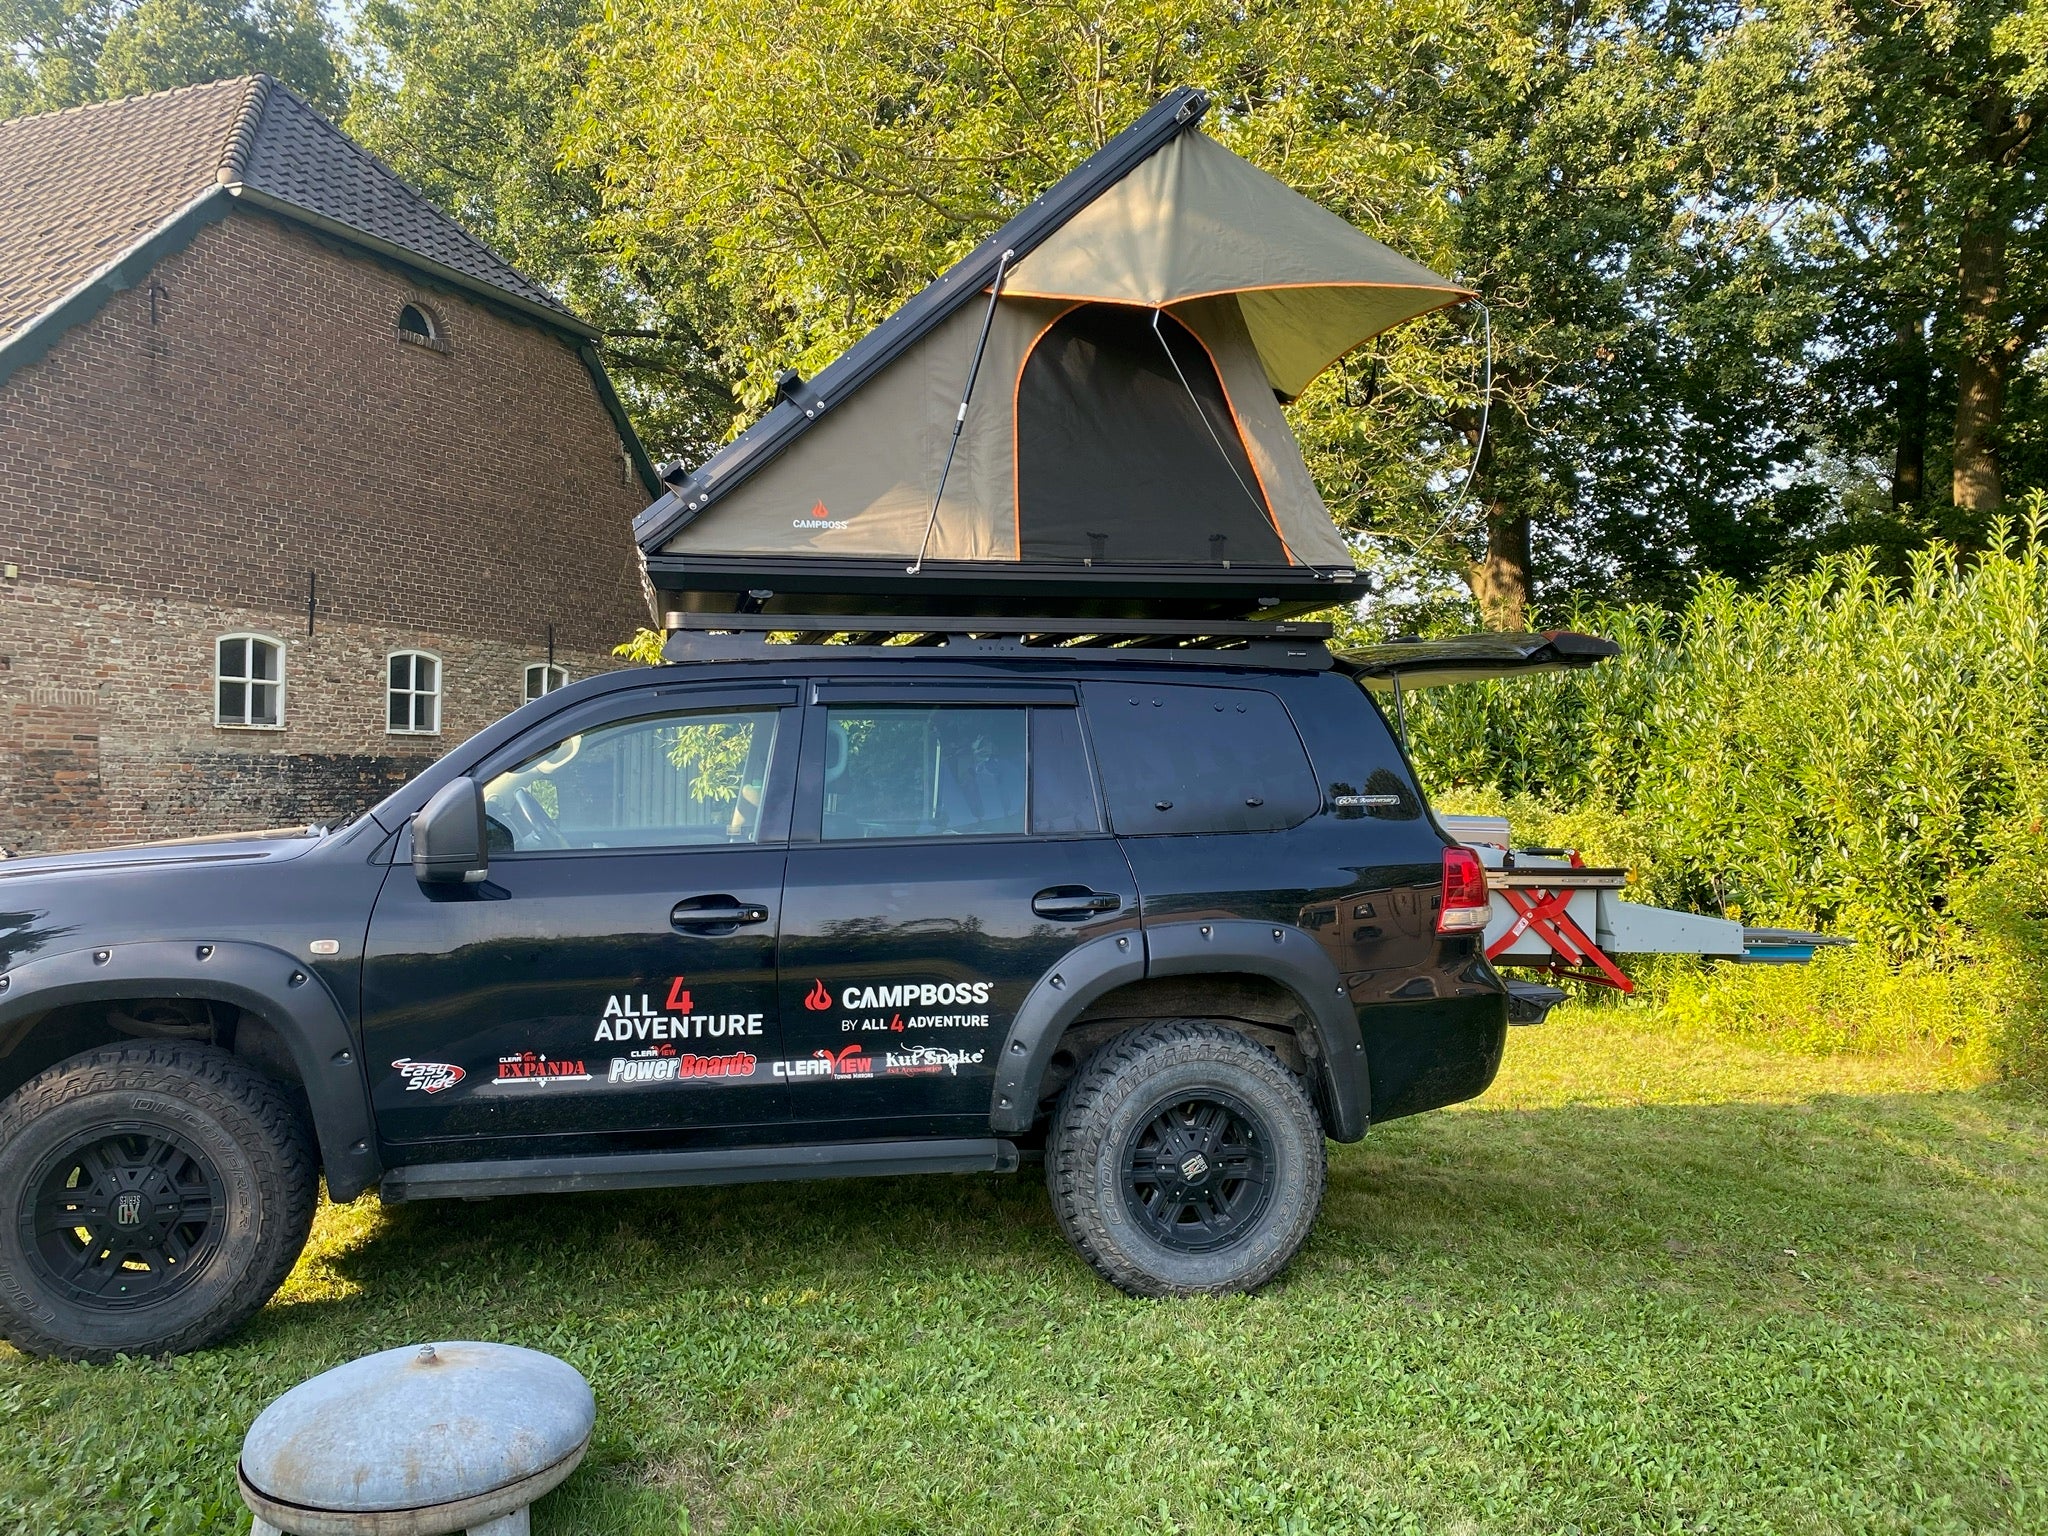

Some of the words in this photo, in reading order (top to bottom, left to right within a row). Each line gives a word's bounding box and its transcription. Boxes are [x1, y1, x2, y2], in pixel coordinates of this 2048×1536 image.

[793, 520, 847, 530] CAMPBOSS
[1359, 796, 1396, 805] Anniversary
[603, 994, 658, 1018] ALL
[665, 976, 694, 1015] 4
[842, 982, 990, 1010] CAMPBOSS
[594, 1013, 764, 1042] ADVENTURE
[841, 1019, 859, 1032] BY
[861, 1018, 888, 1031] ALL
[890, 1013, 905, 1033] 4
[907, 1014, 990, 1029] ADVENTURE
[608, 1057, 680, 1084] Power
[678, 1051, 757, 1080] Boards
[886, 1052, 921, 1067] Kut
[924, 1049, 983, 1067] Snake
[401, 1062, 448, 1078] Easy
[498, 1060, 586, 1078] EXPANDA
[406, 1076, 456, 1091] Slide
[131, 1098, 251, 1230] DISCOVERER
[1102, 1109, 1132, 1224] COOPER
[1252, 1088, 1299, 1240] DISCOVERER
[120, 1195, 140, 1205] SERIES
